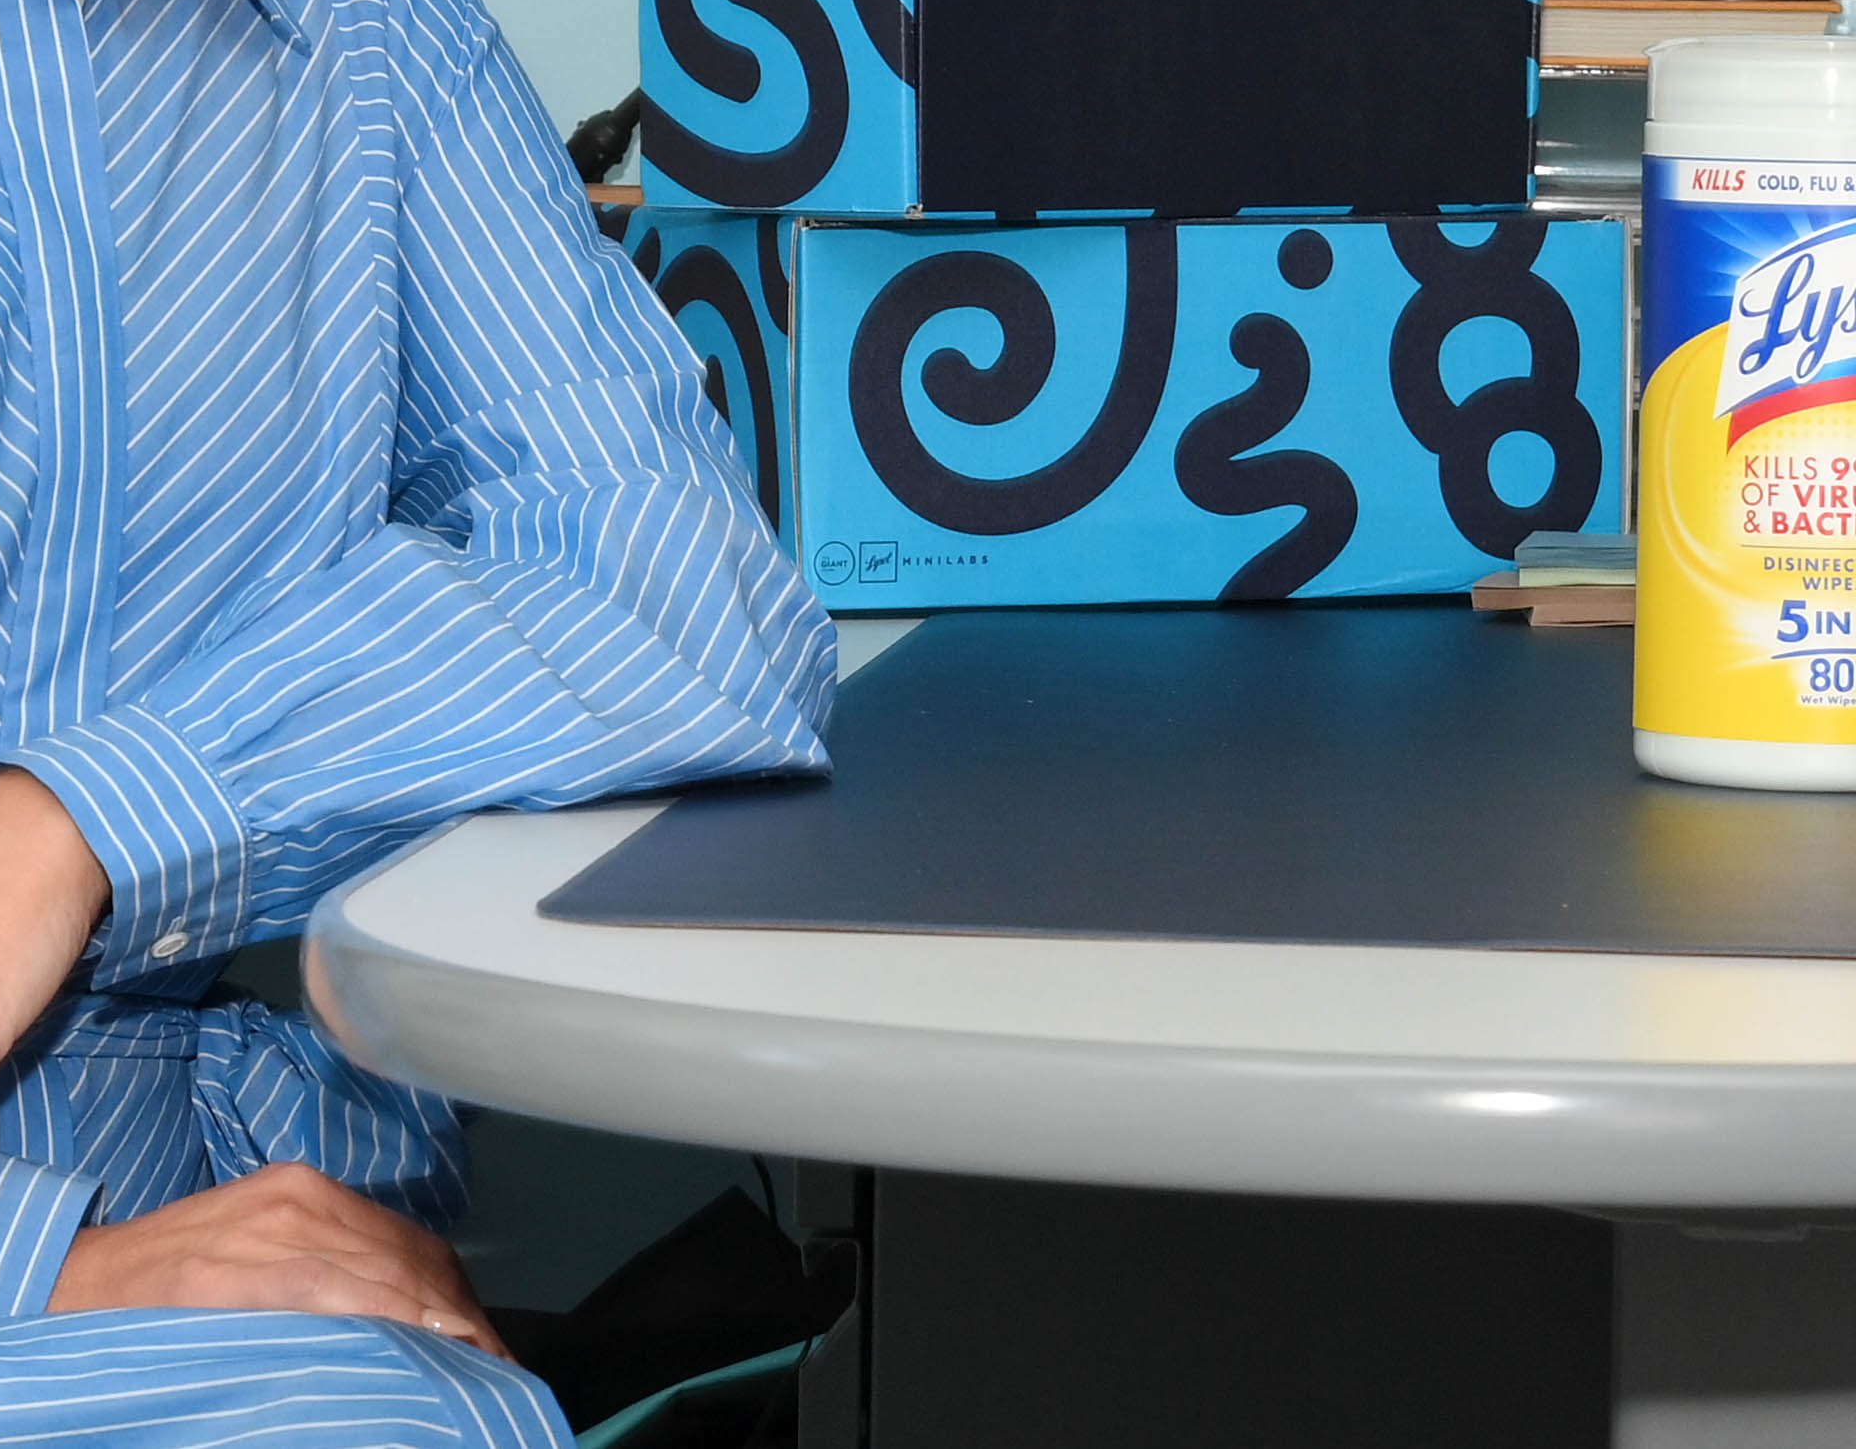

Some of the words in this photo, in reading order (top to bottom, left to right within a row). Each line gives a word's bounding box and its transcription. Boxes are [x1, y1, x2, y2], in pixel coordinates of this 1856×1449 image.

[1692, 168, 1746, 192] KILLS
[1757, 174, 1803, 193] COLD,
[1810, 175, 1837, 192] FLU
[1843, 176, 1855, 192] &
[1744, 455, 1818, 481] KILLS
[1741, 482, 1780, 507] OF
[1743, 510, 1761, 534] &
[902, 555, 989, 566] MINILABS
[1776, 599, 1809, 643] 5
[1815, 611, 1851, 635] IN
[1809, 658, 1855, 693] 80
[1801, 695, 1823, 705] Wet
